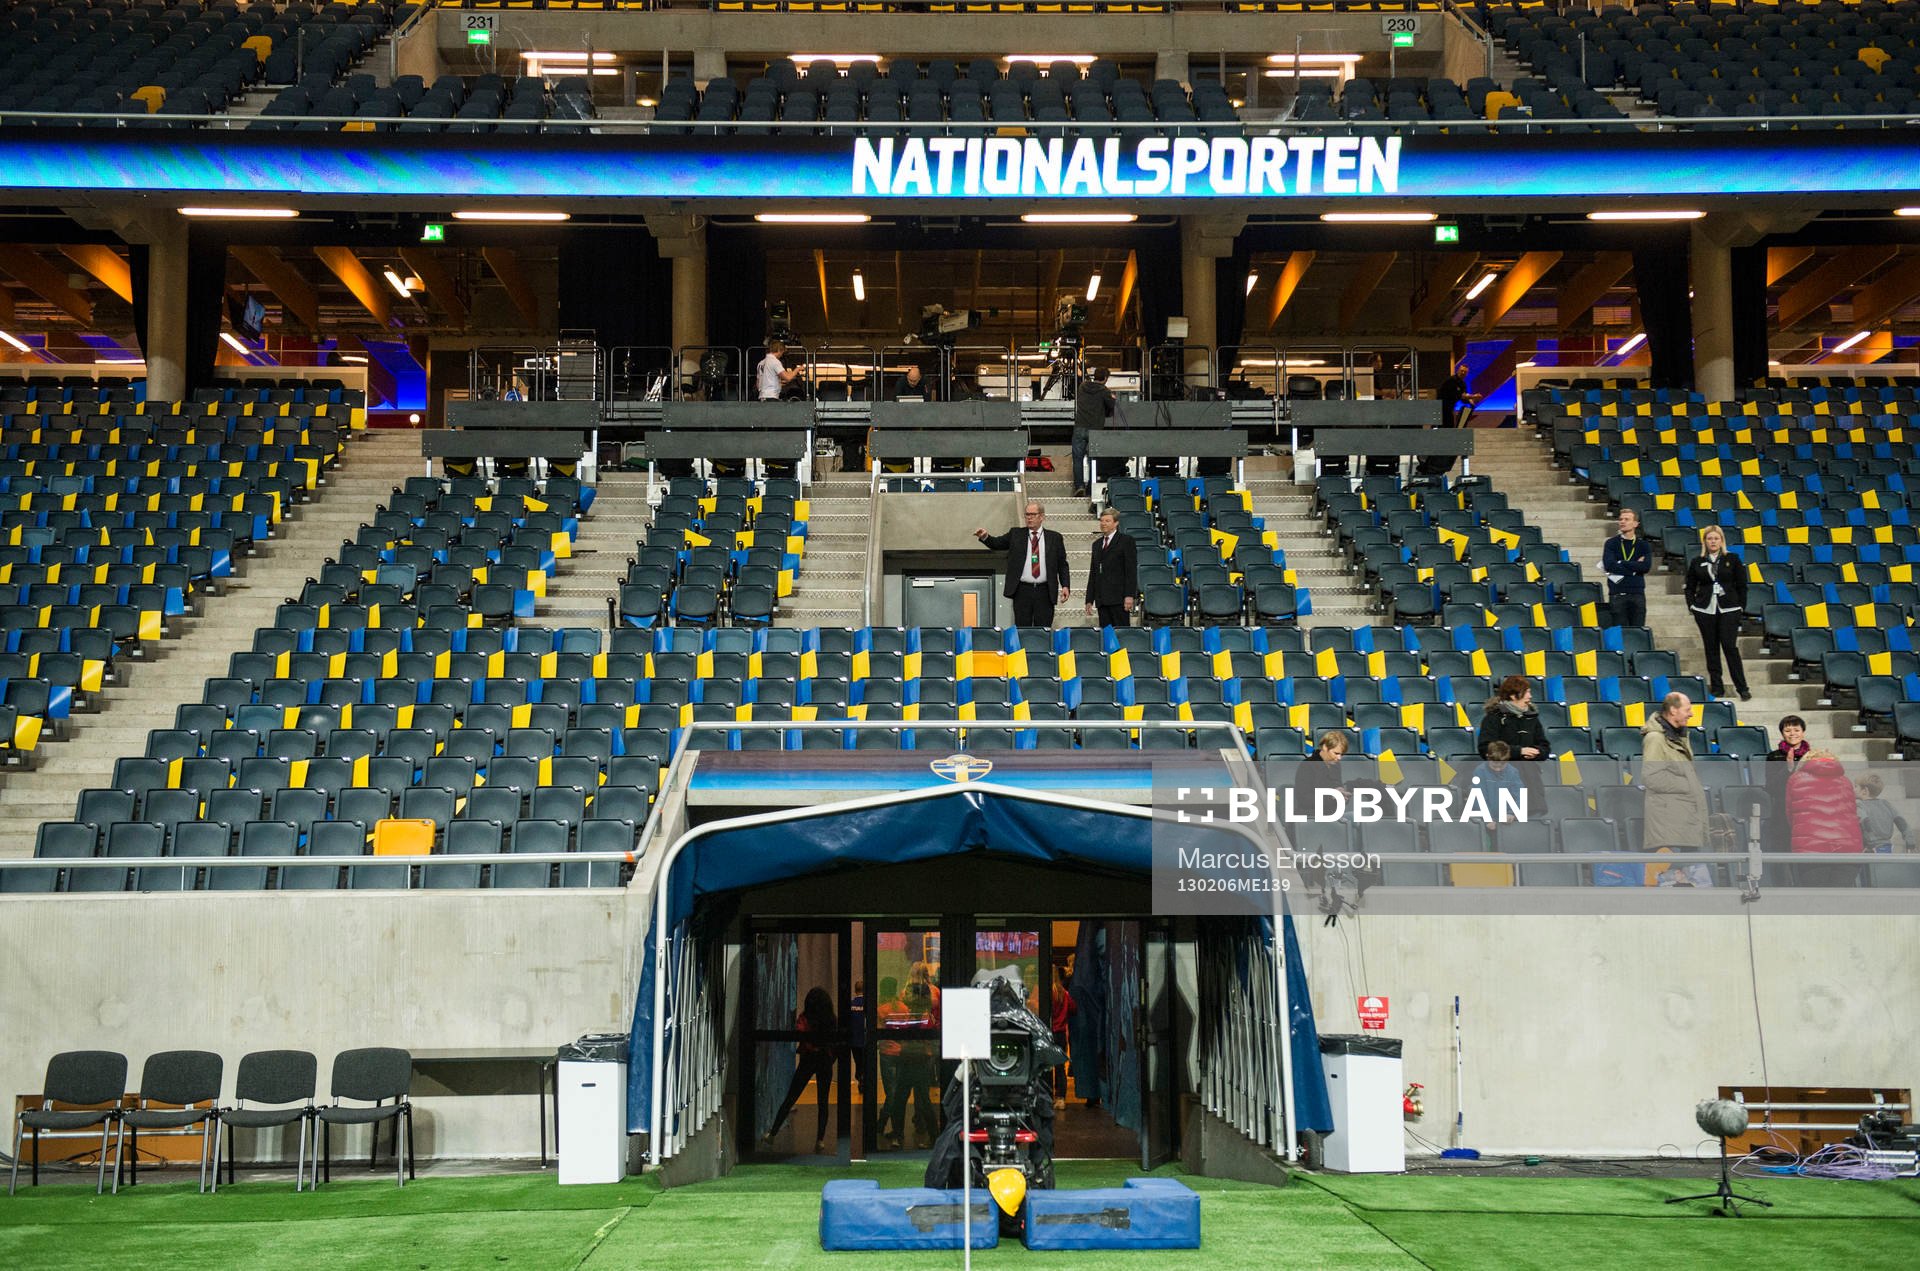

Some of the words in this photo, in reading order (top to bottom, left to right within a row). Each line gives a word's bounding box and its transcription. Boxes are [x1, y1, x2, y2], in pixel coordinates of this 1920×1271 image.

[467, 15, 493, 29] 231
[1387, 18, 1416, 32] 230
[852, 137, 1402, 195] NATIONALSPORTEN
